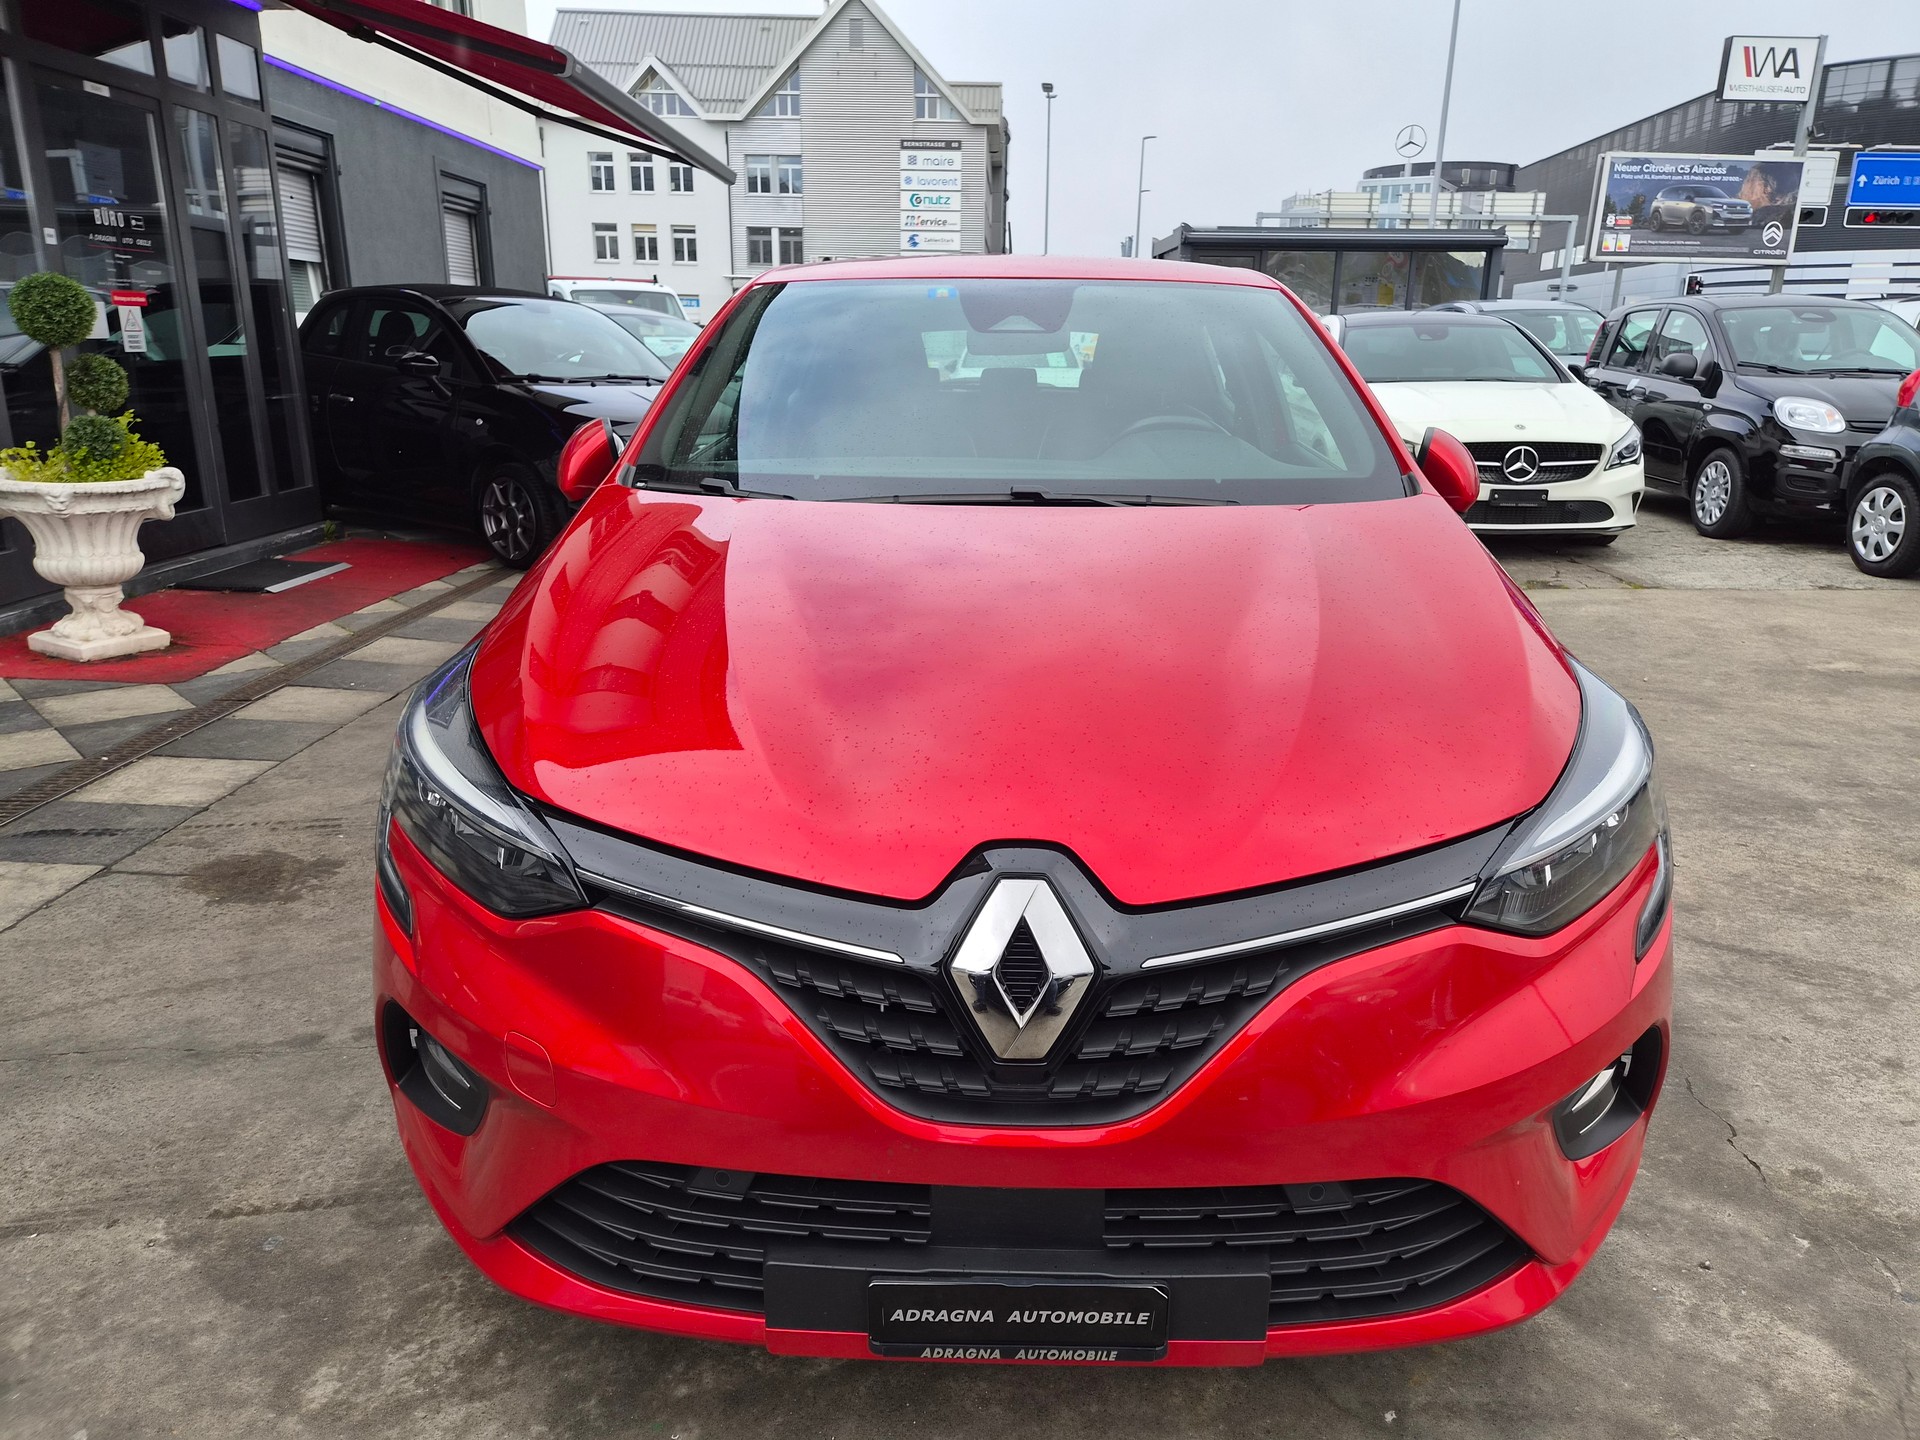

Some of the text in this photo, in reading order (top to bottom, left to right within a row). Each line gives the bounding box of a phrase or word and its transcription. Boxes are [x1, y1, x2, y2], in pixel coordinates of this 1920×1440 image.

[1729, 84, 1806, 94] WESTHAUSER AUTO
[922, 155, 954, 166] maire
[1614, 163, 1727, 175] Neuer Citroën C5 Aircross
[917, 176, 958, 186] lavorent
[1872, 175, 1901, 185] Zürich
[923, 195, 951, 205] nutz
[93, 206, 125, 228] BÜRO
[890, 1309, 1150, 1325] ADRAGNA AUTOMOBILE
[920, 1347, 1118, 1361] ADRAGNA AUTOMOBILE
